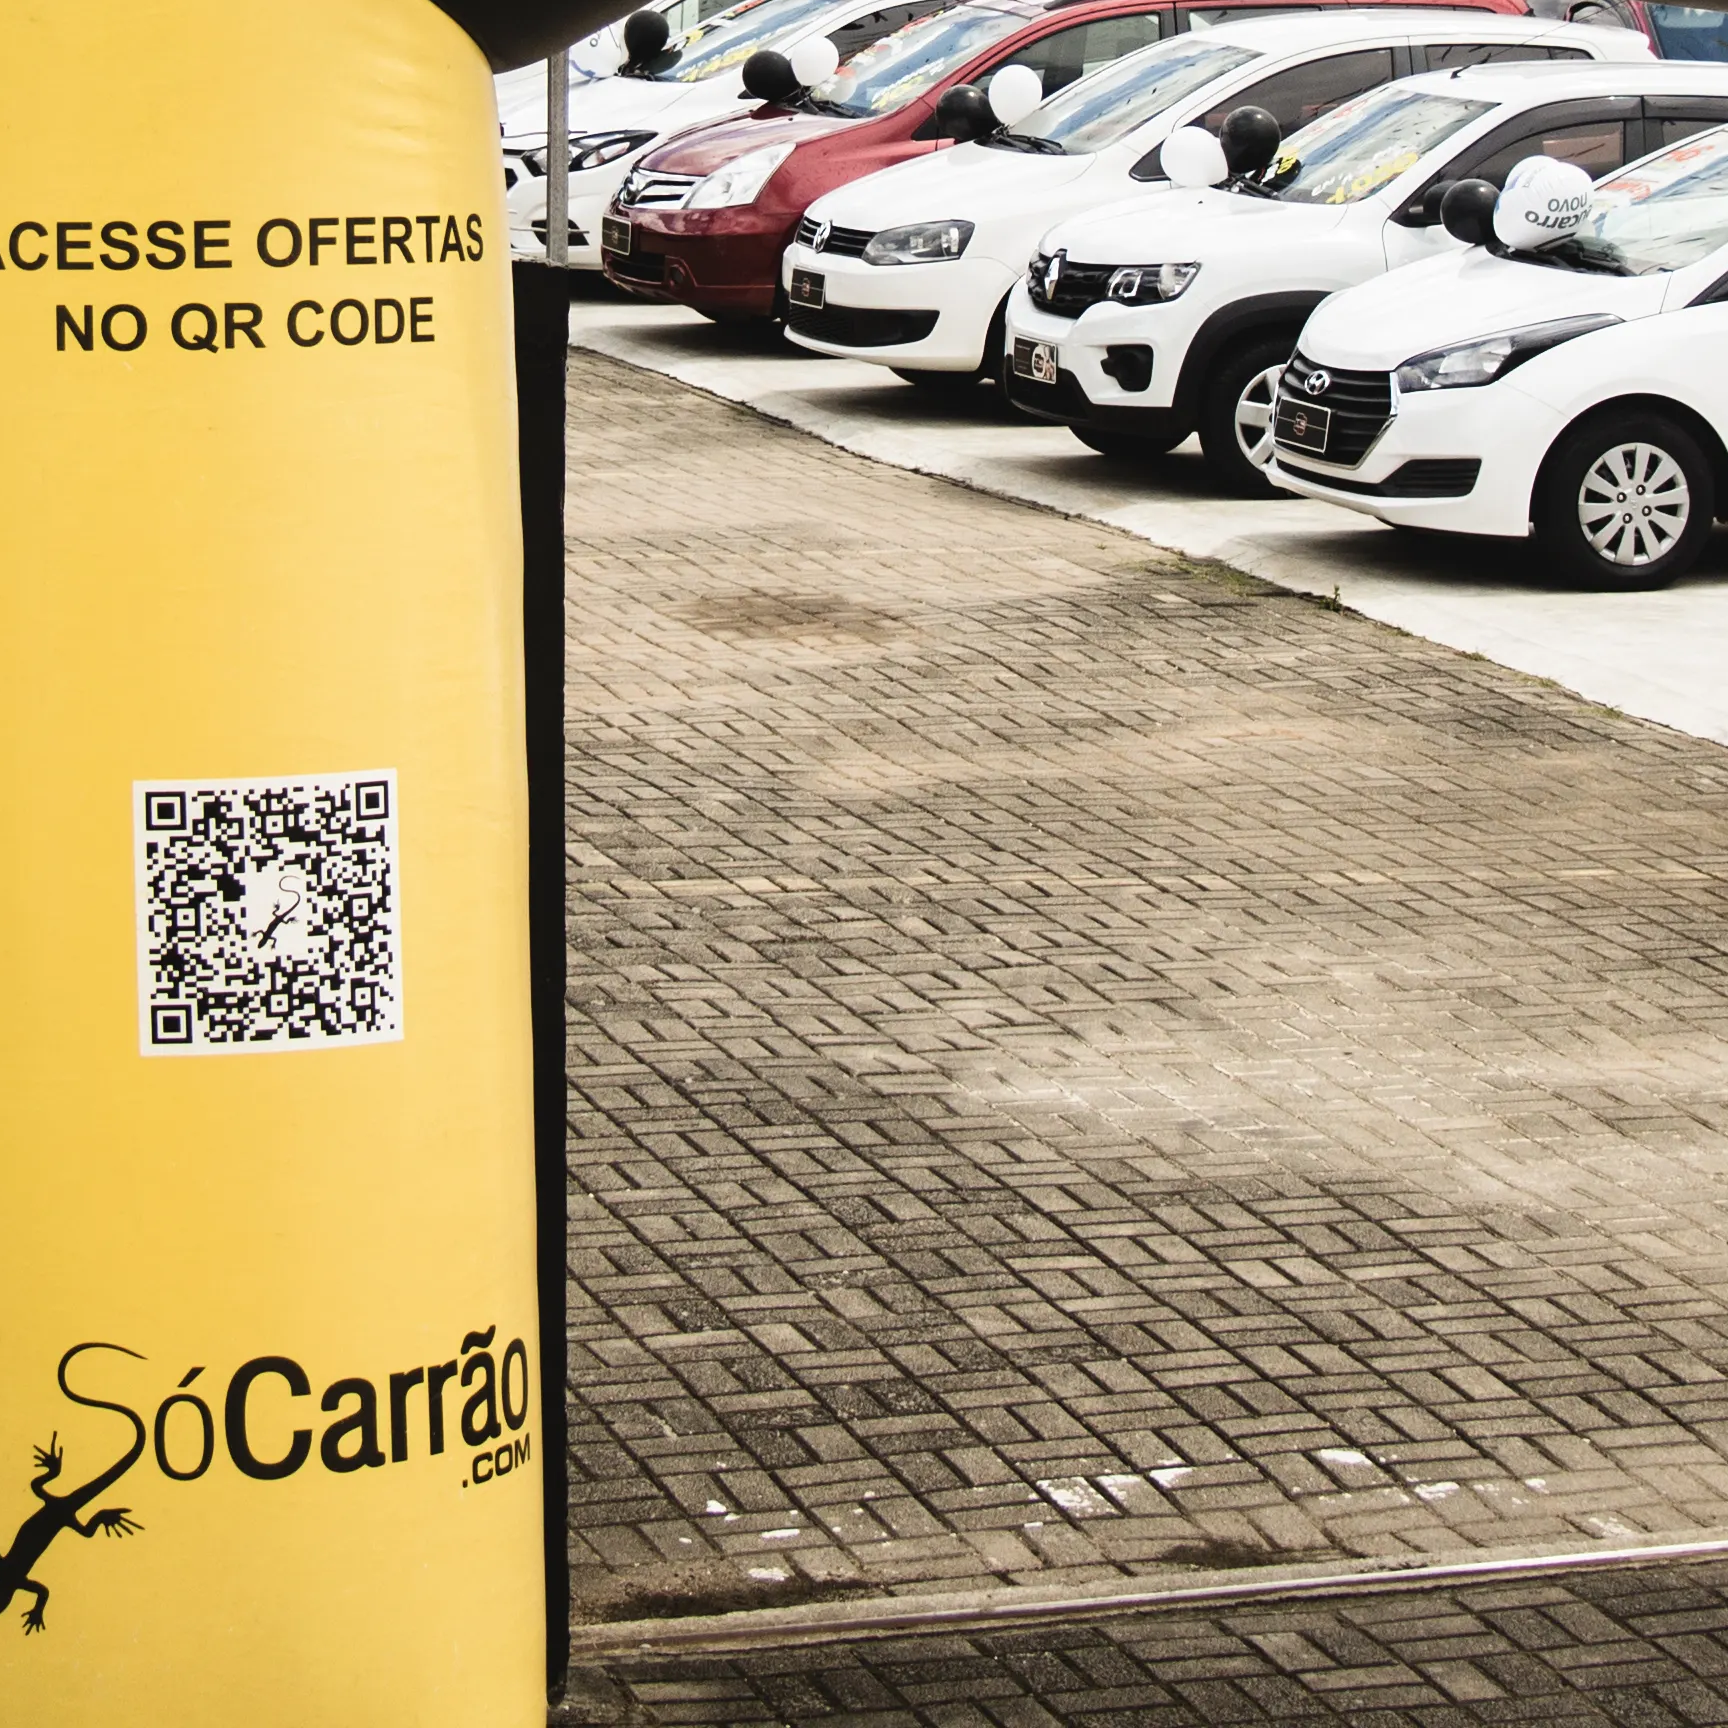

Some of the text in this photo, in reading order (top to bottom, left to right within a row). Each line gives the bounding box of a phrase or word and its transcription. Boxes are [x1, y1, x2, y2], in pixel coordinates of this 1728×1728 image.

[1525, 204, 1592, 229] ucarro
[1548, 192, 1587, 212] novo
[257, 214, 483, 267] OFERTAS
[56, 297, 434, 353] NO QR CODE
[461, 1434, 530, 1489] .COM
